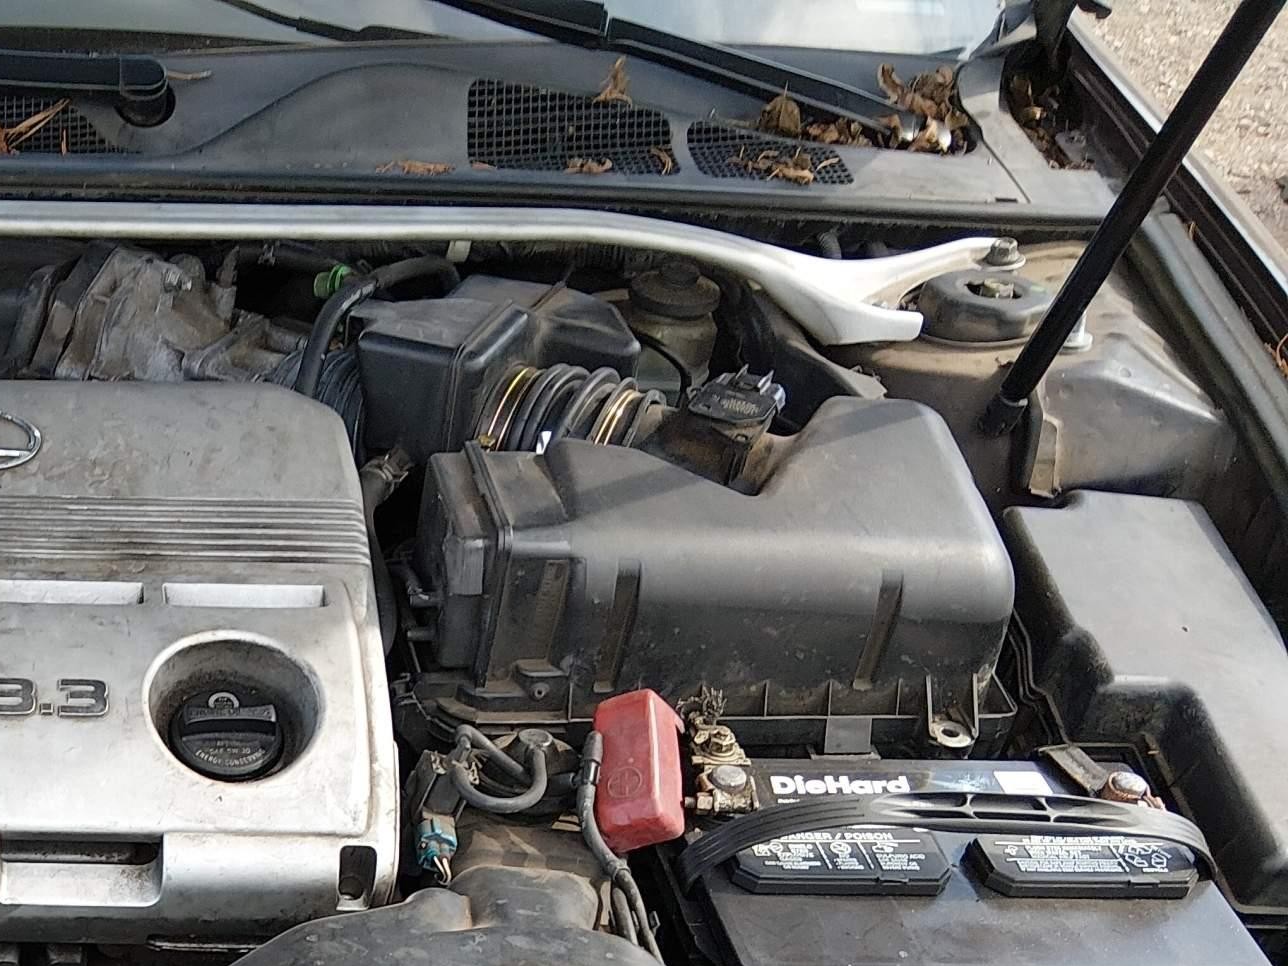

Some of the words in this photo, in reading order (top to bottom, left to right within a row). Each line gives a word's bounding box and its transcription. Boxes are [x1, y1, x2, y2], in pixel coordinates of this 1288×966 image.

[195, 749, 222, 765] ENERGY
[770, 775, 911, 794] DieHard
[844, 832, 894, 840] POISON
